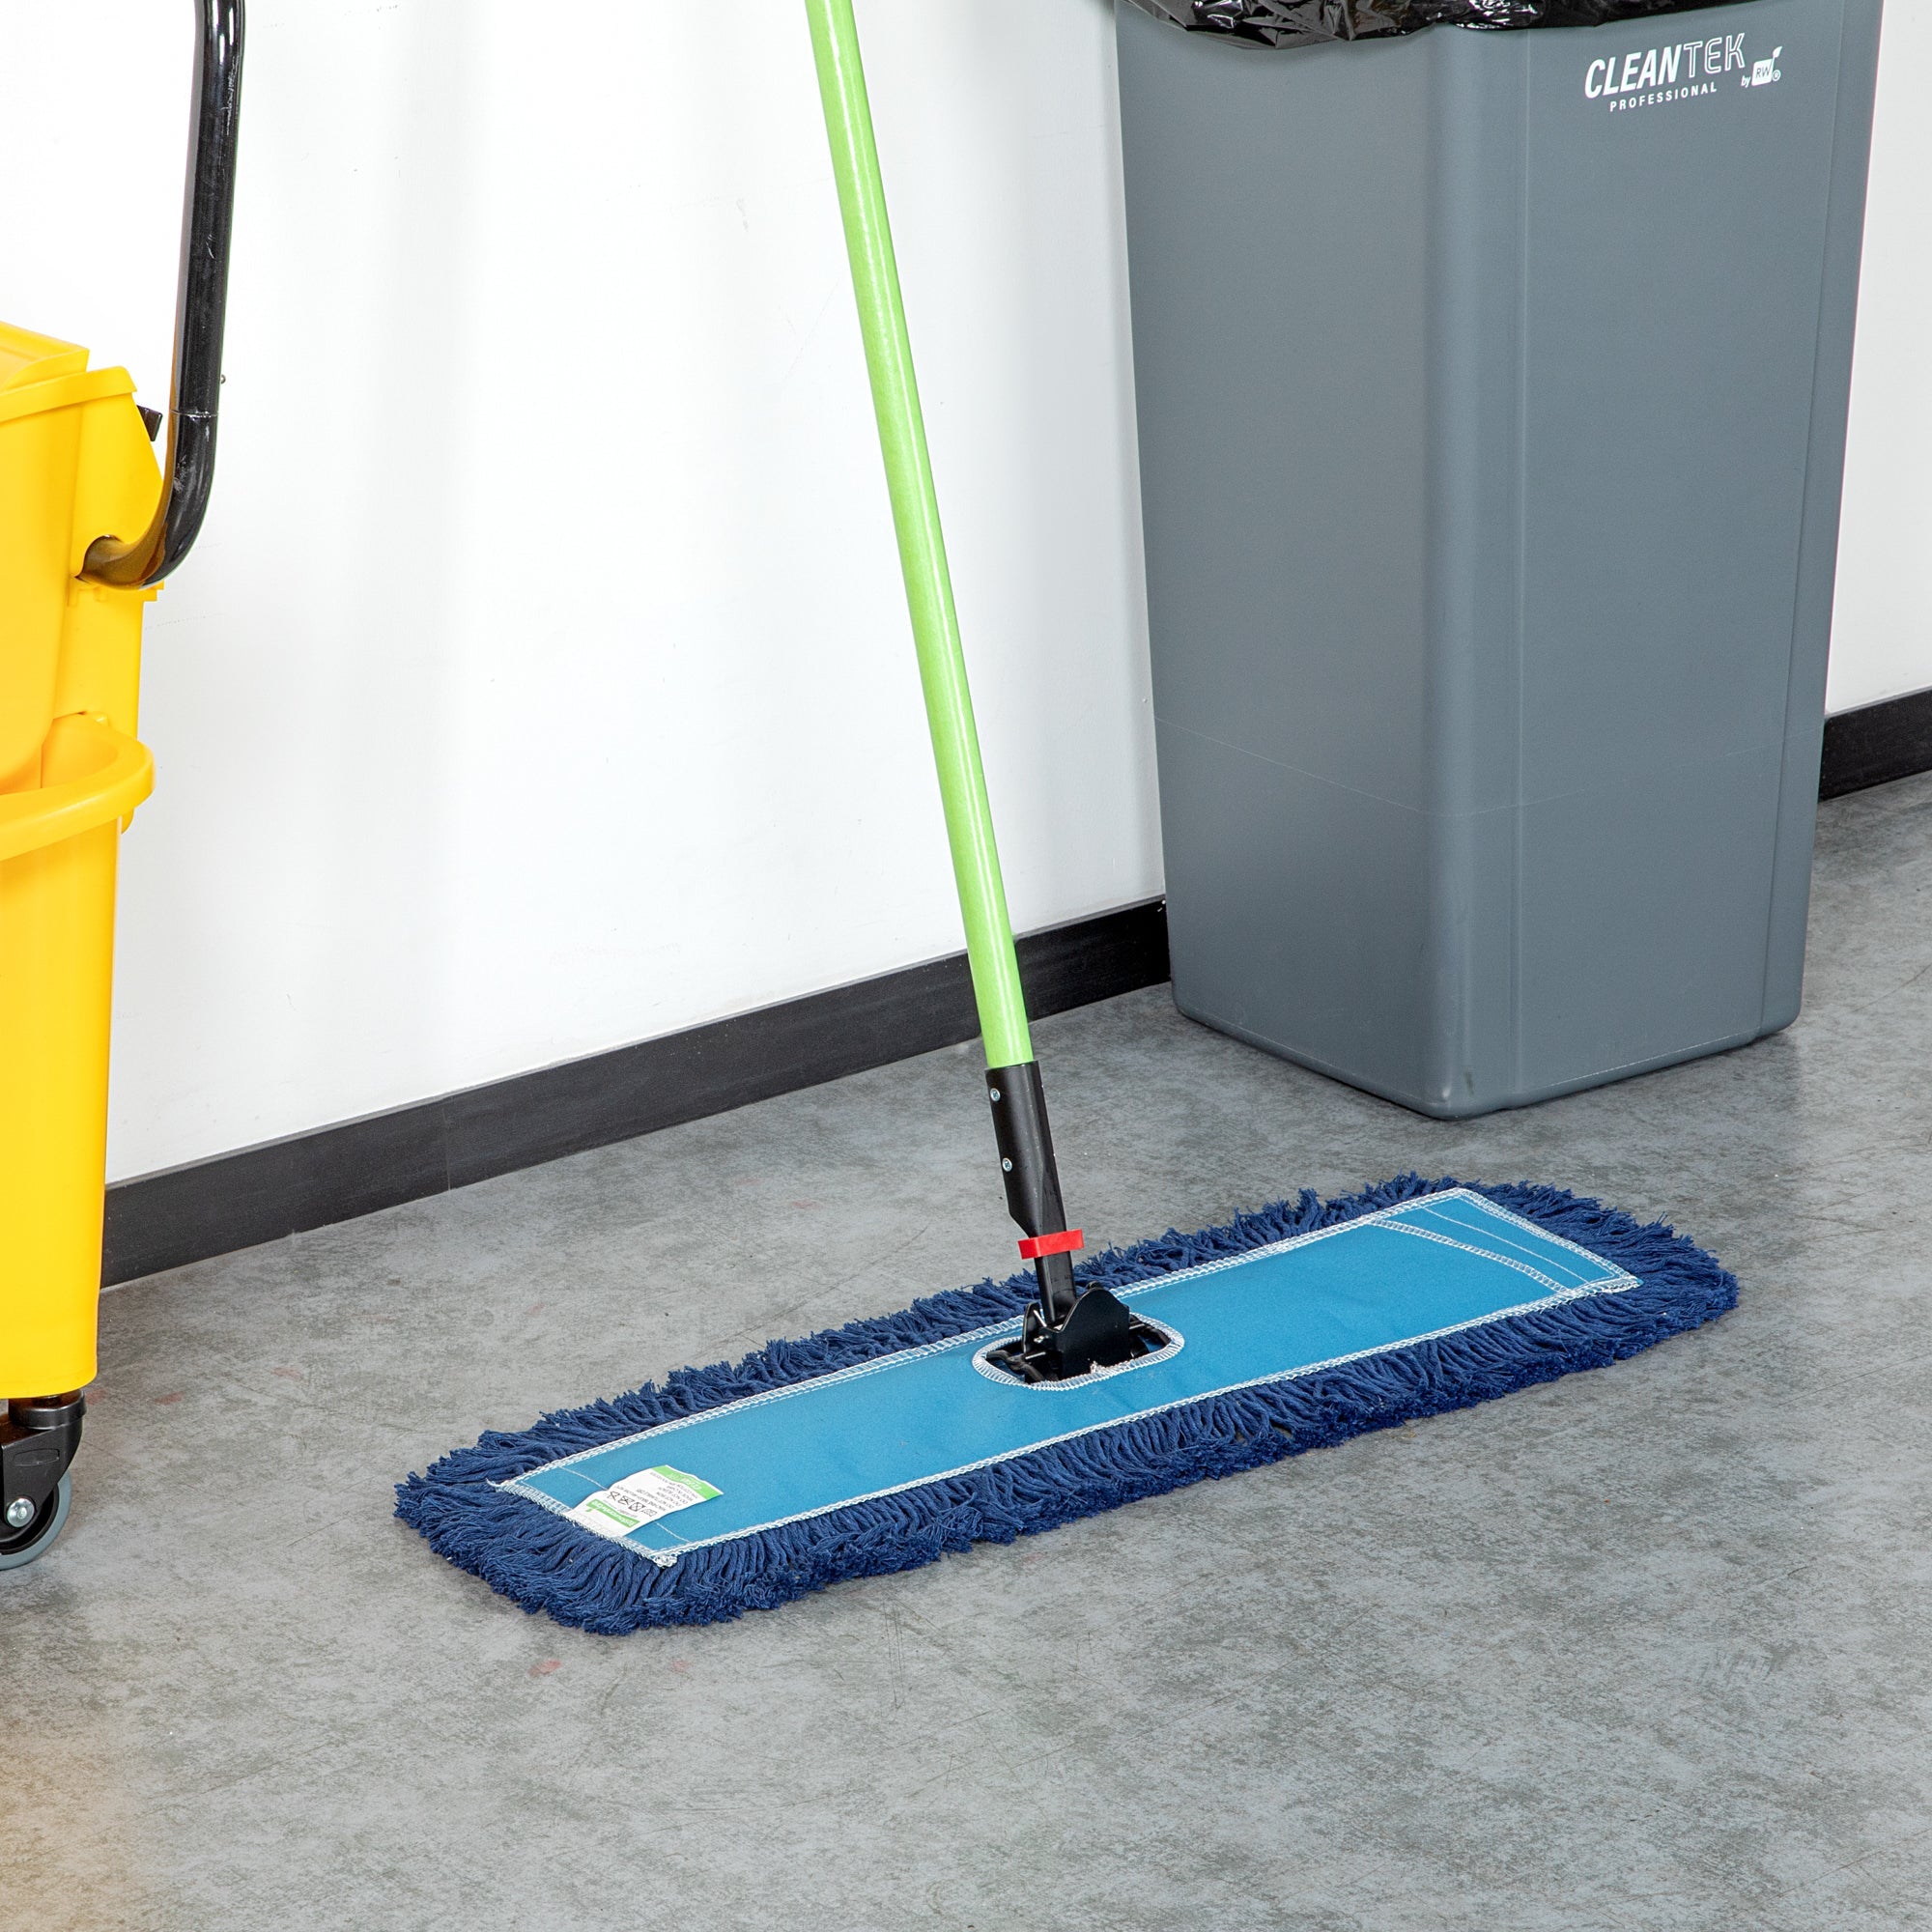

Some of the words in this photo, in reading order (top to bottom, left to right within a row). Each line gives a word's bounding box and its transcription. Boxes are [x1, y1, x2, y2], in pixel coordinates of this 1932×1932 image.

[1584, 32, 1746, 99] CLEANTEK
[1741, 74, 1751, 89] by
[1755, 66, 1772, 80] RW
[1609, 81, 1718, 112] PROFESSIONAL
